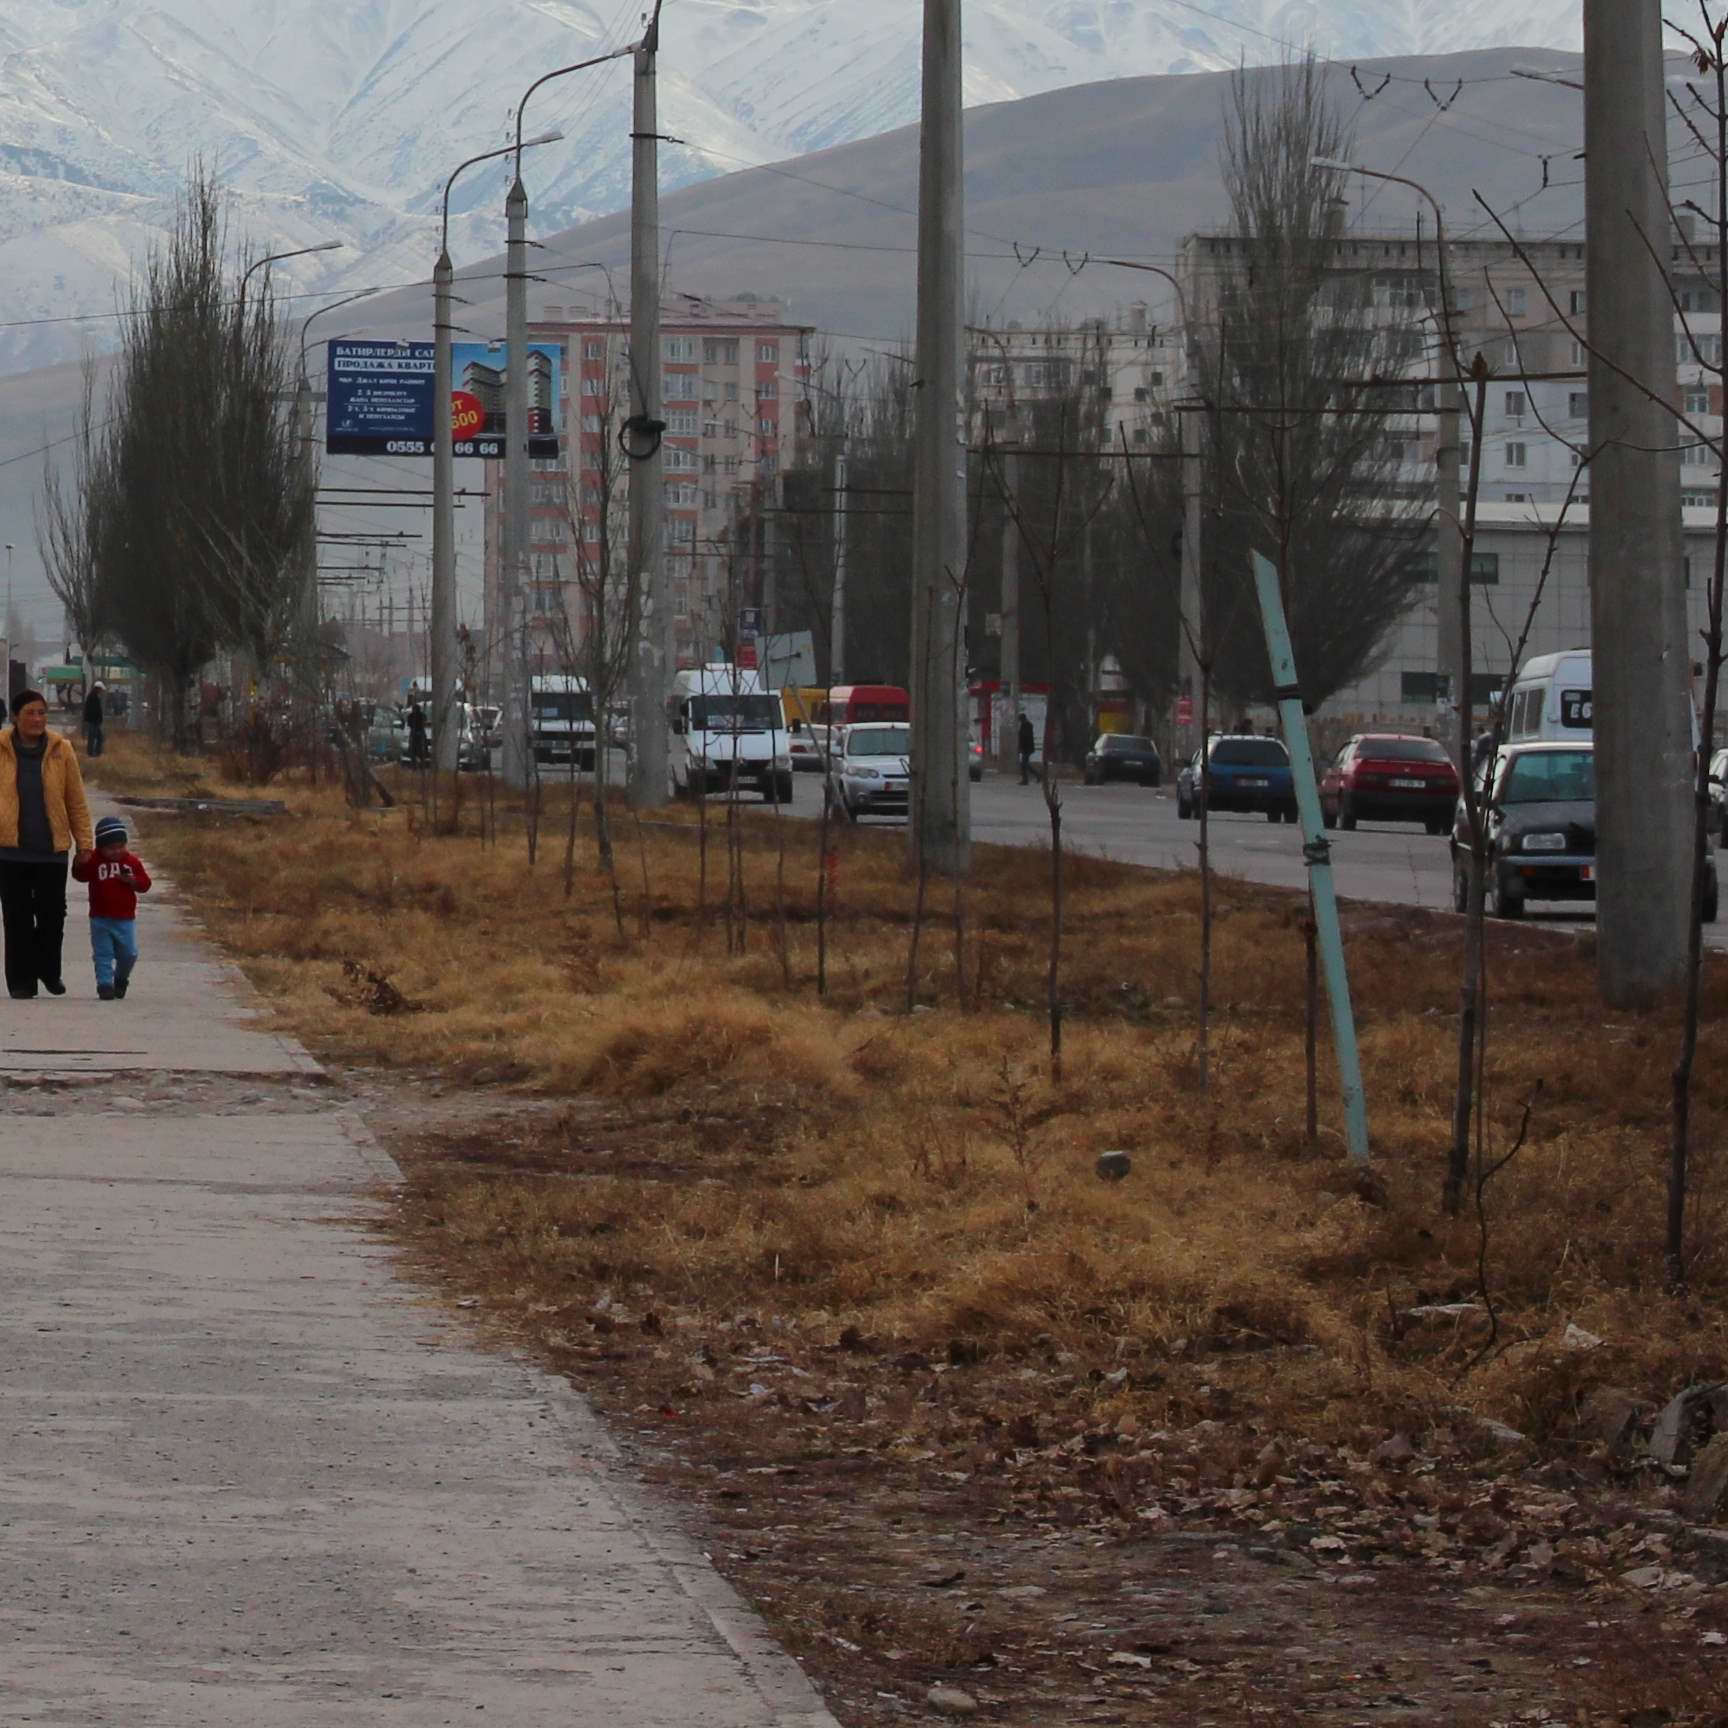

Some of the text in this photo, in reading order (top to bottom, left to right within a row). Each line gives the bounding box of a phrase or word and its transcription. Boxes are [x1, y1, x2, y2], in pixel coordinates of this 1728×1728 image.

[337, 359, 435, 371] ПРОДАЖА КВАРТ
[386, 440, 425, 453] 0555
[479, 442, 499, 455] 66
